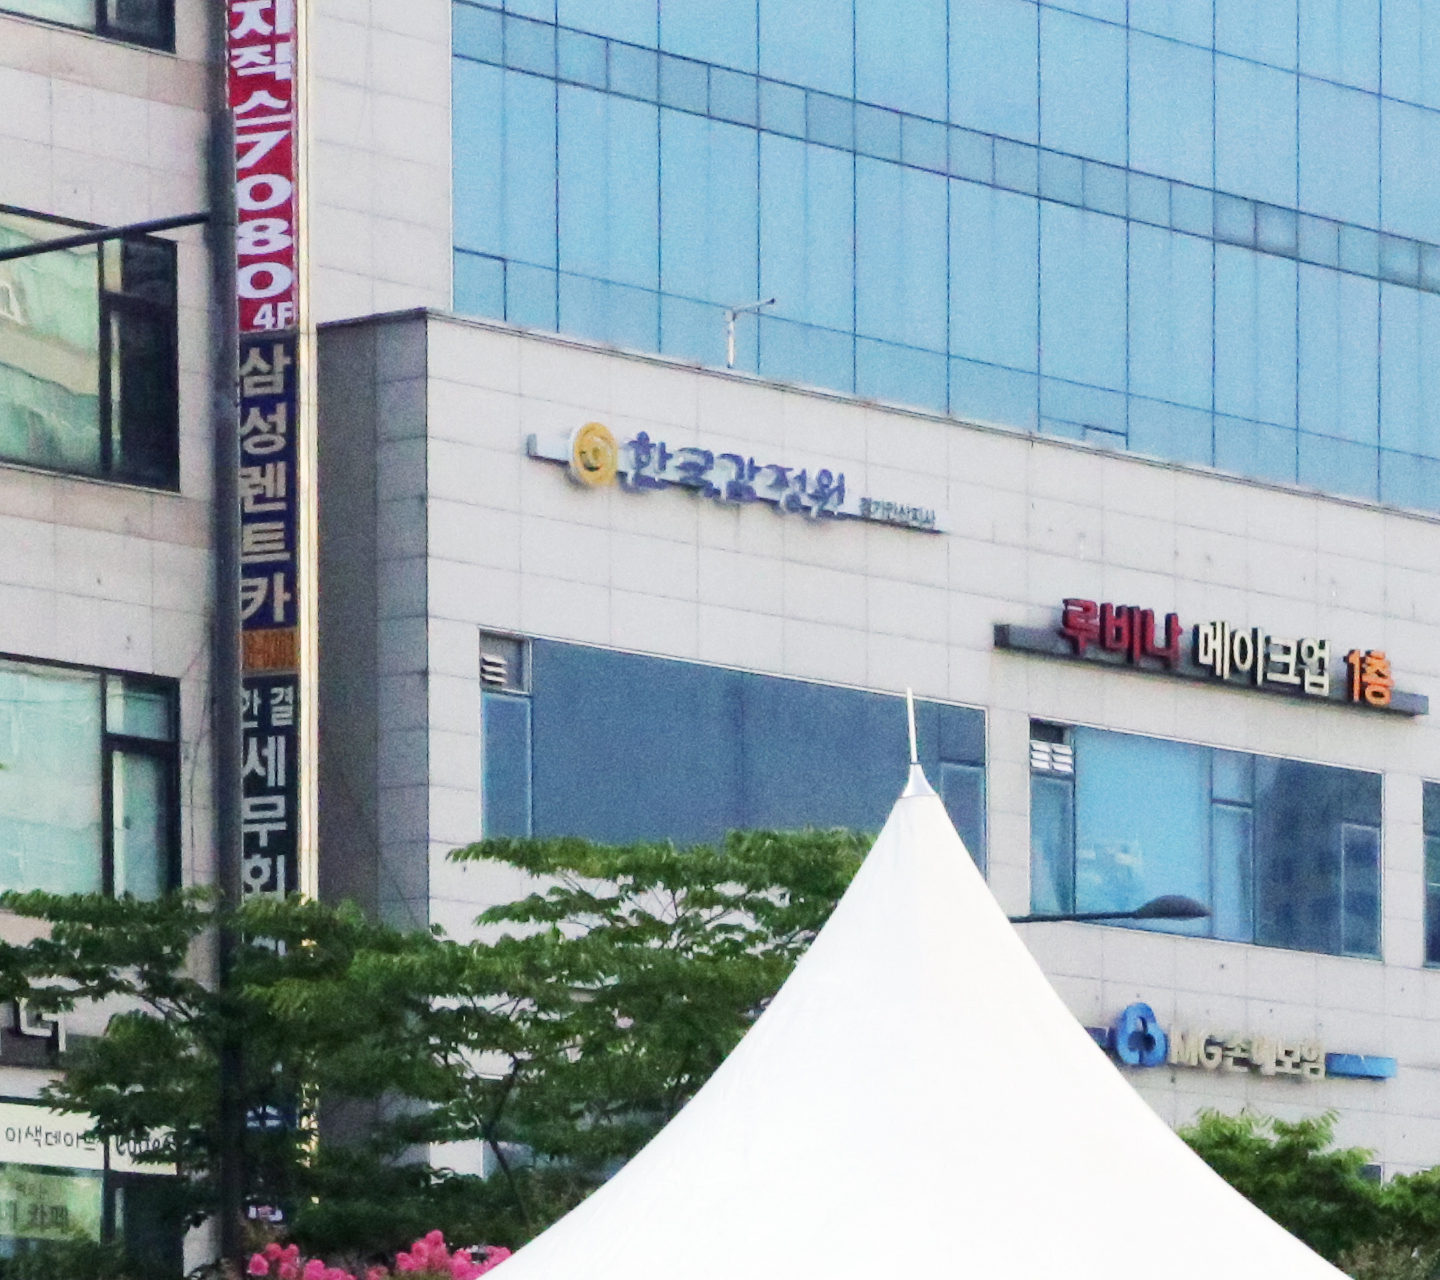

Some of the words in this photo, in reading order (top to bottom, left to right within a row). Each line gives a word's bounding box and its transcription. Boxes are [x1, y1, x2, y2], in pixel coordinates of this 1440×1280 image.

[240, 343, 292, 624] 삼성렌트카
[627, 430, 846, 523] 한국감정원
[1062, 597, 1183, 668] 루비나
[1193, 619, 1333, 697] 메이크업
[1343, 648, 1395, 707] 1층
